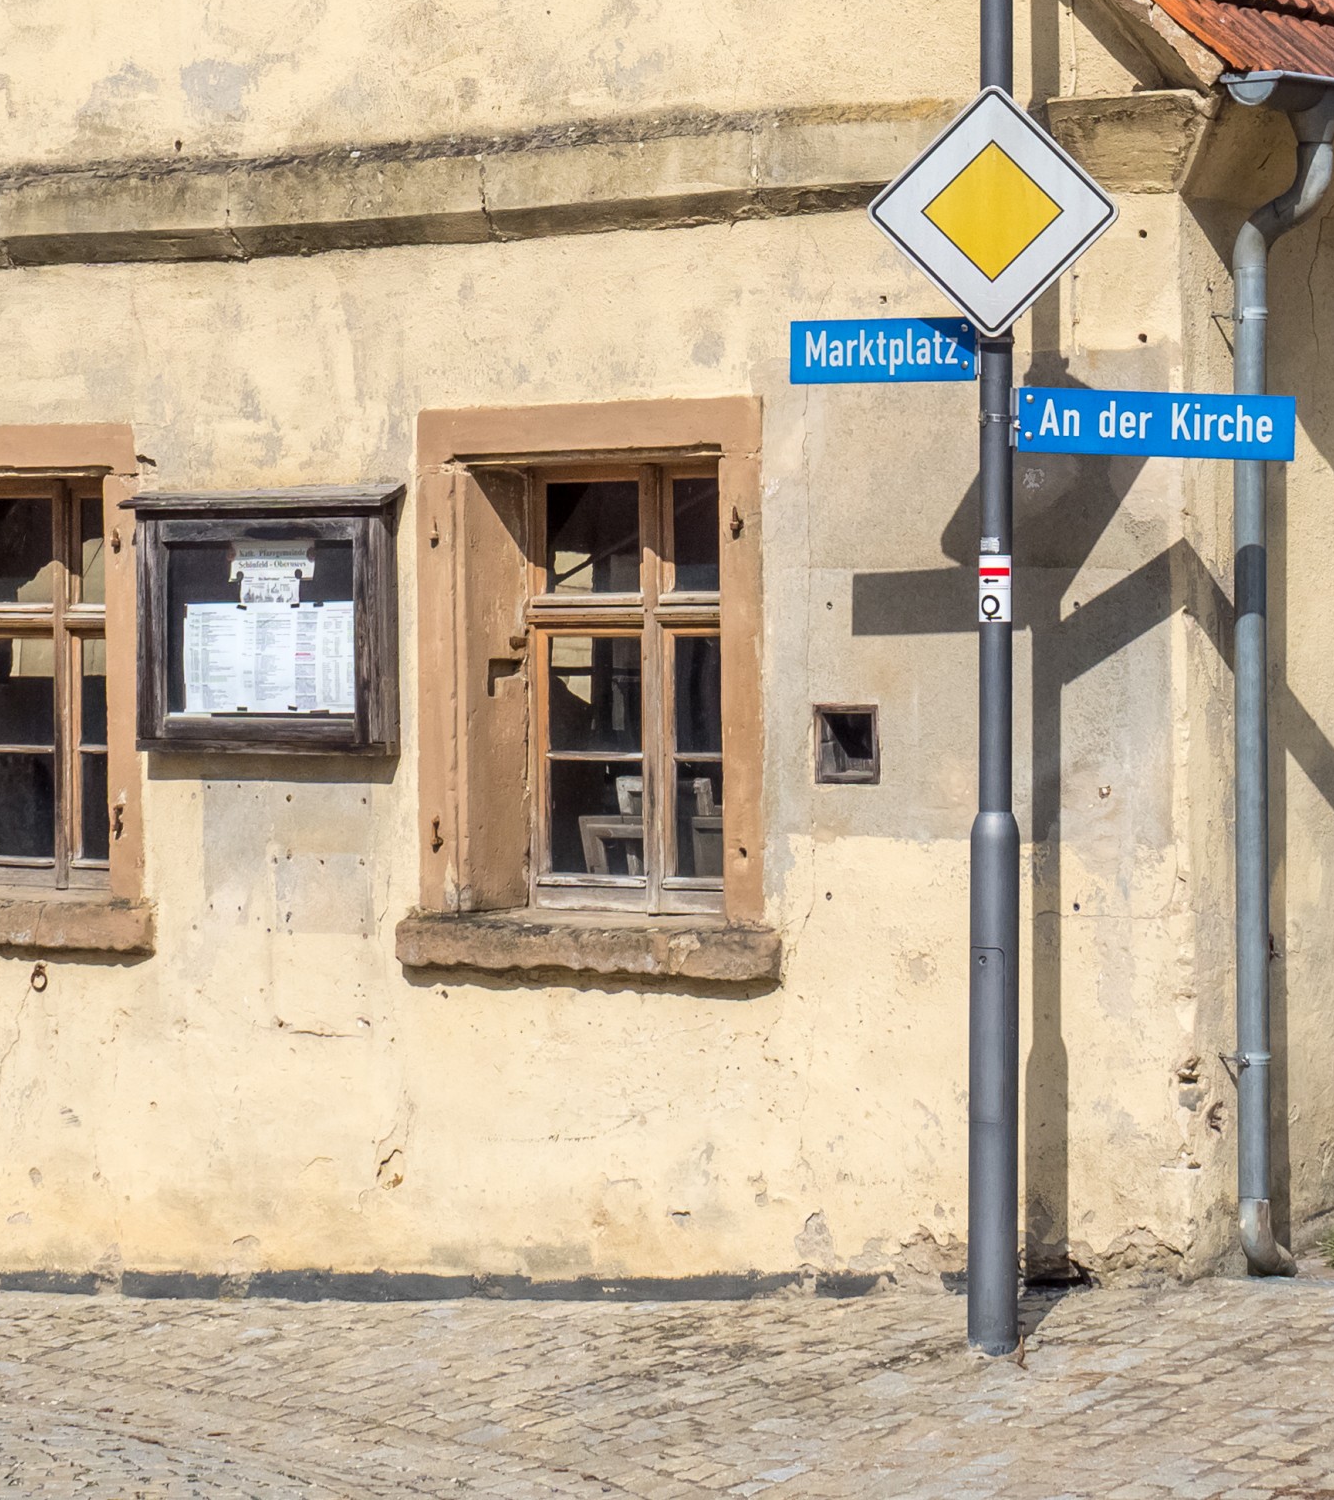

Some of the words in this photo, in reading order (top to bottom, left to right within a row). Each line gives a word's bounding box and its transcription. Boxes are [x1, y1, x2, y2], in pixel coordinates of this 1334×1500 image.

[805, 328, 959, 376] Marktplatz
[1039, 398, 1081, 437] An
[1098, 400, 1153, 440] der
[1171, 402, 1274, 443] Kirche
